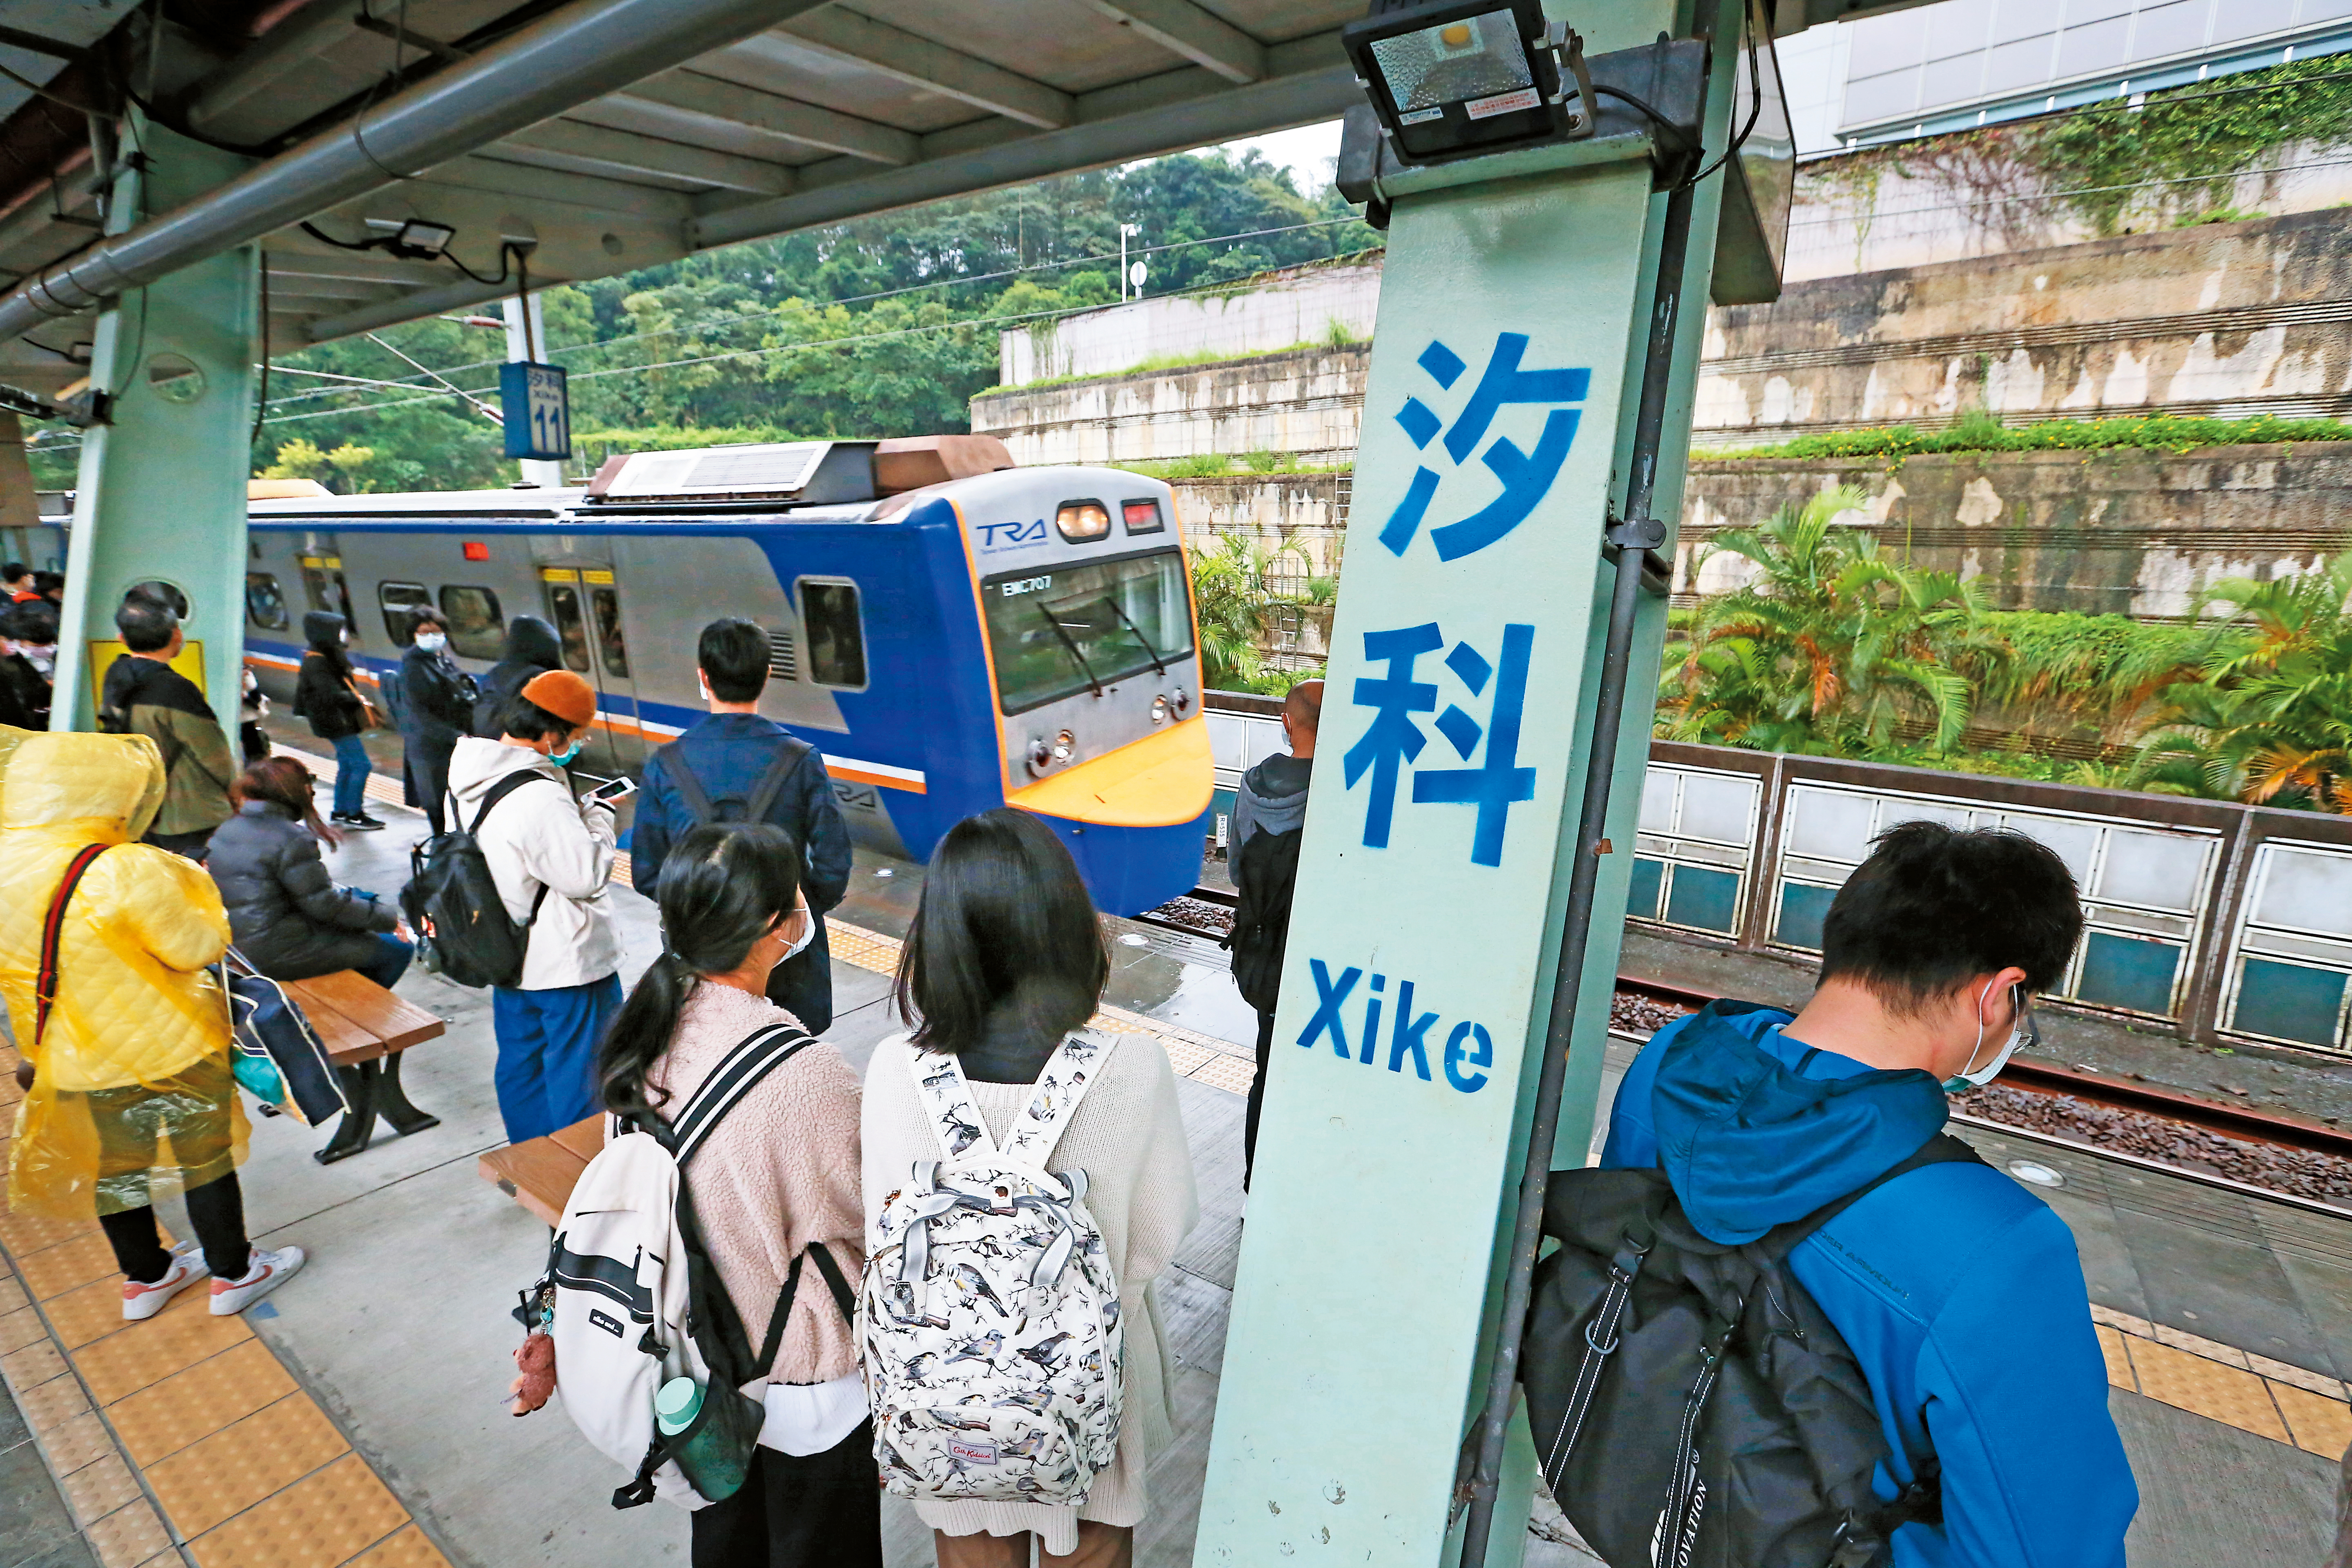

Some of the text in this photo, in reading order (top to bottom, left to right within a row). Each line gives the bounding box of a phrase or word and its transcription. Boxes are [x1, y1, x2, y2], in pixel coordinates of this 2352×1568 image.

[535, 403, 561, 452] 11
[976, 519, 1048, 546] TRA
[1343, 332, 1591, 867] 汐科
[1296, 958, 1493, 1094] Xike
[953, 1446, 967, 1454] Cath
[966, 1450, 991, 1458] Kidston
